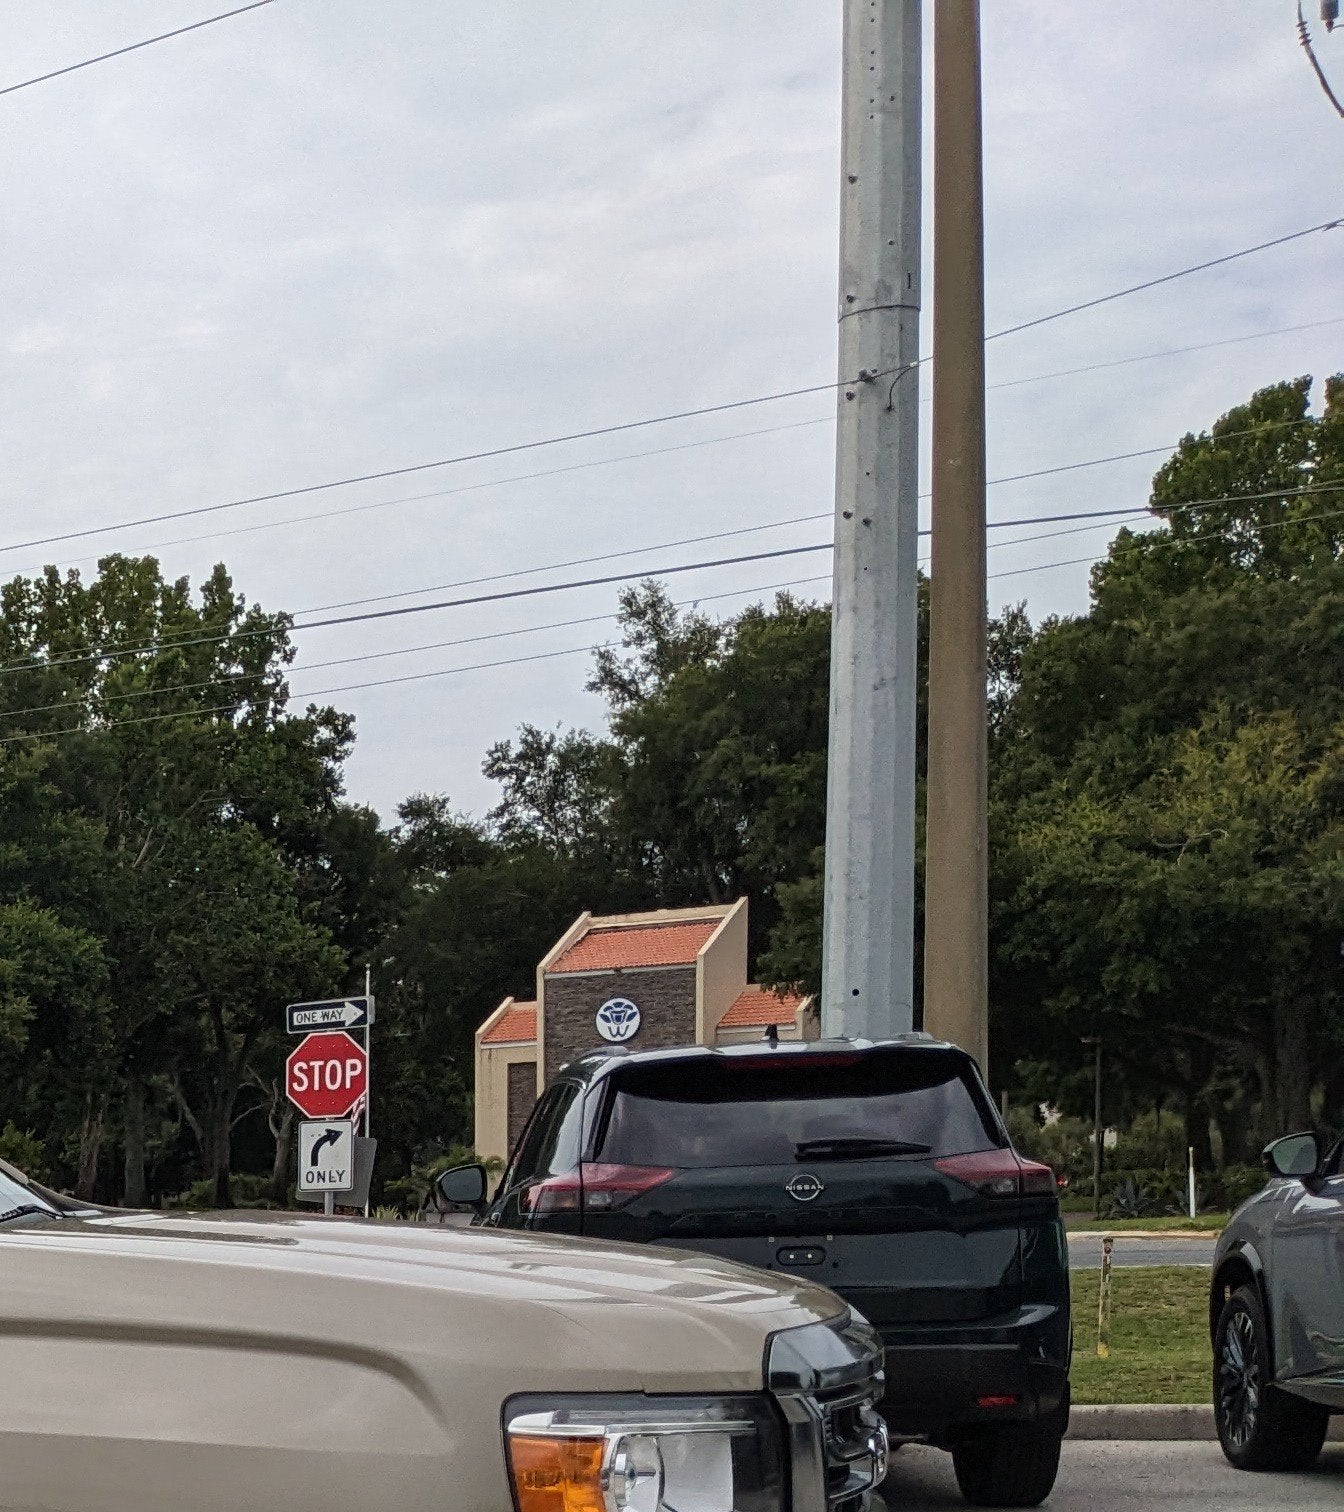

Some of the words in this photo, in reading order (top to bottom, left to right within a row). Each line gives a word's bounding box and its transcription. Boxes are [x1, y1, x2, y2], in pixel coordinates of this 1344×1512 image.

[295, 1010, 318, 1024] ONE
[320, 1008, 344, 1022] WAY
[292, 1058, 363, 1092] STOP
[305, 1169, 346, 1184] ONLY
